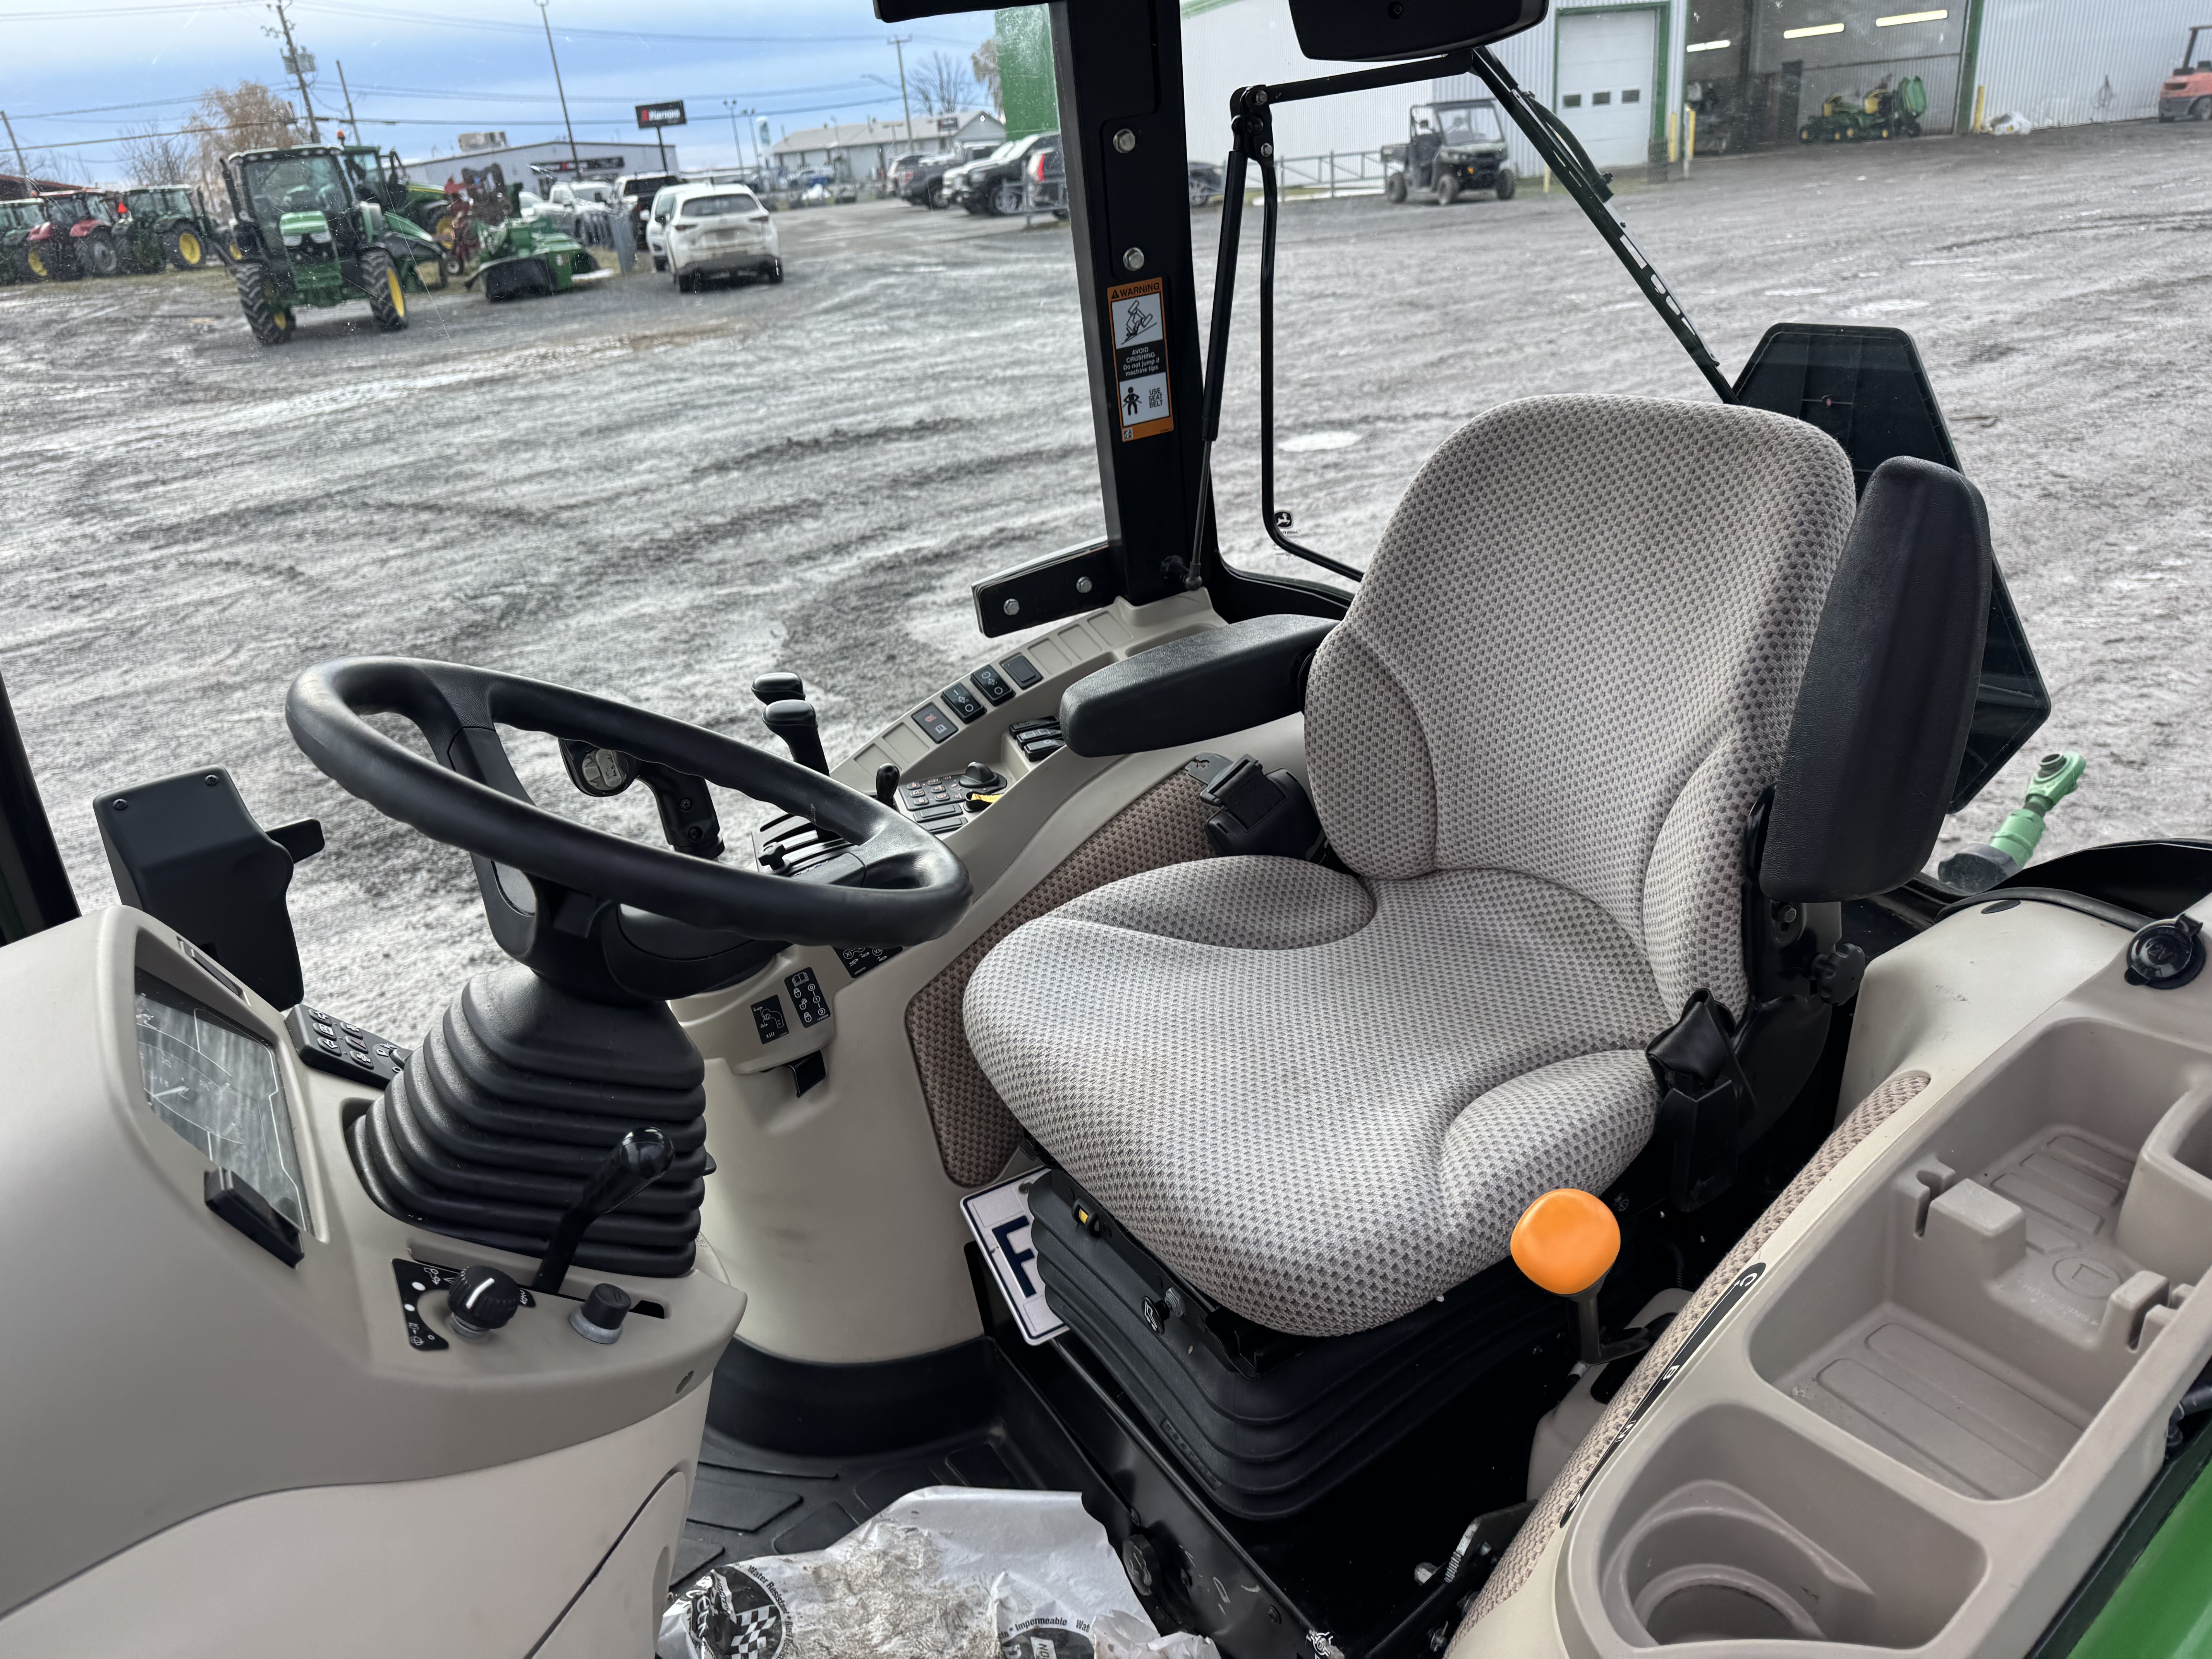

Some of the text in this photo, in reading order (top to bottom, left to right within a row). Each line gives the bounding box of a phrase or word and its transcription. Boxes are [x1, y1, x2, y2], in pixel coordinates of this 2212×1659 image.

[1120, 283, 1159, 297] WARNING
[1132, 347, 1149, 356] AVOID
[1126, 352, 1155, 363] CRUSHING
[1142, 359, 1155, 368] jump
[1125, 367, 1147, 376] machine
[1149, 393, 1163, 402] SEAT
[1149, 400, 1163, 408] BELT
[1740, 1273, 1757, 1287] C
[1662, 1365, 1680, 1381] B
[748, 1565, 768, 1584] Water
[766, 1581, 790, 1614] Resistant
[1076, 1619, 1091, 1633] Wat
